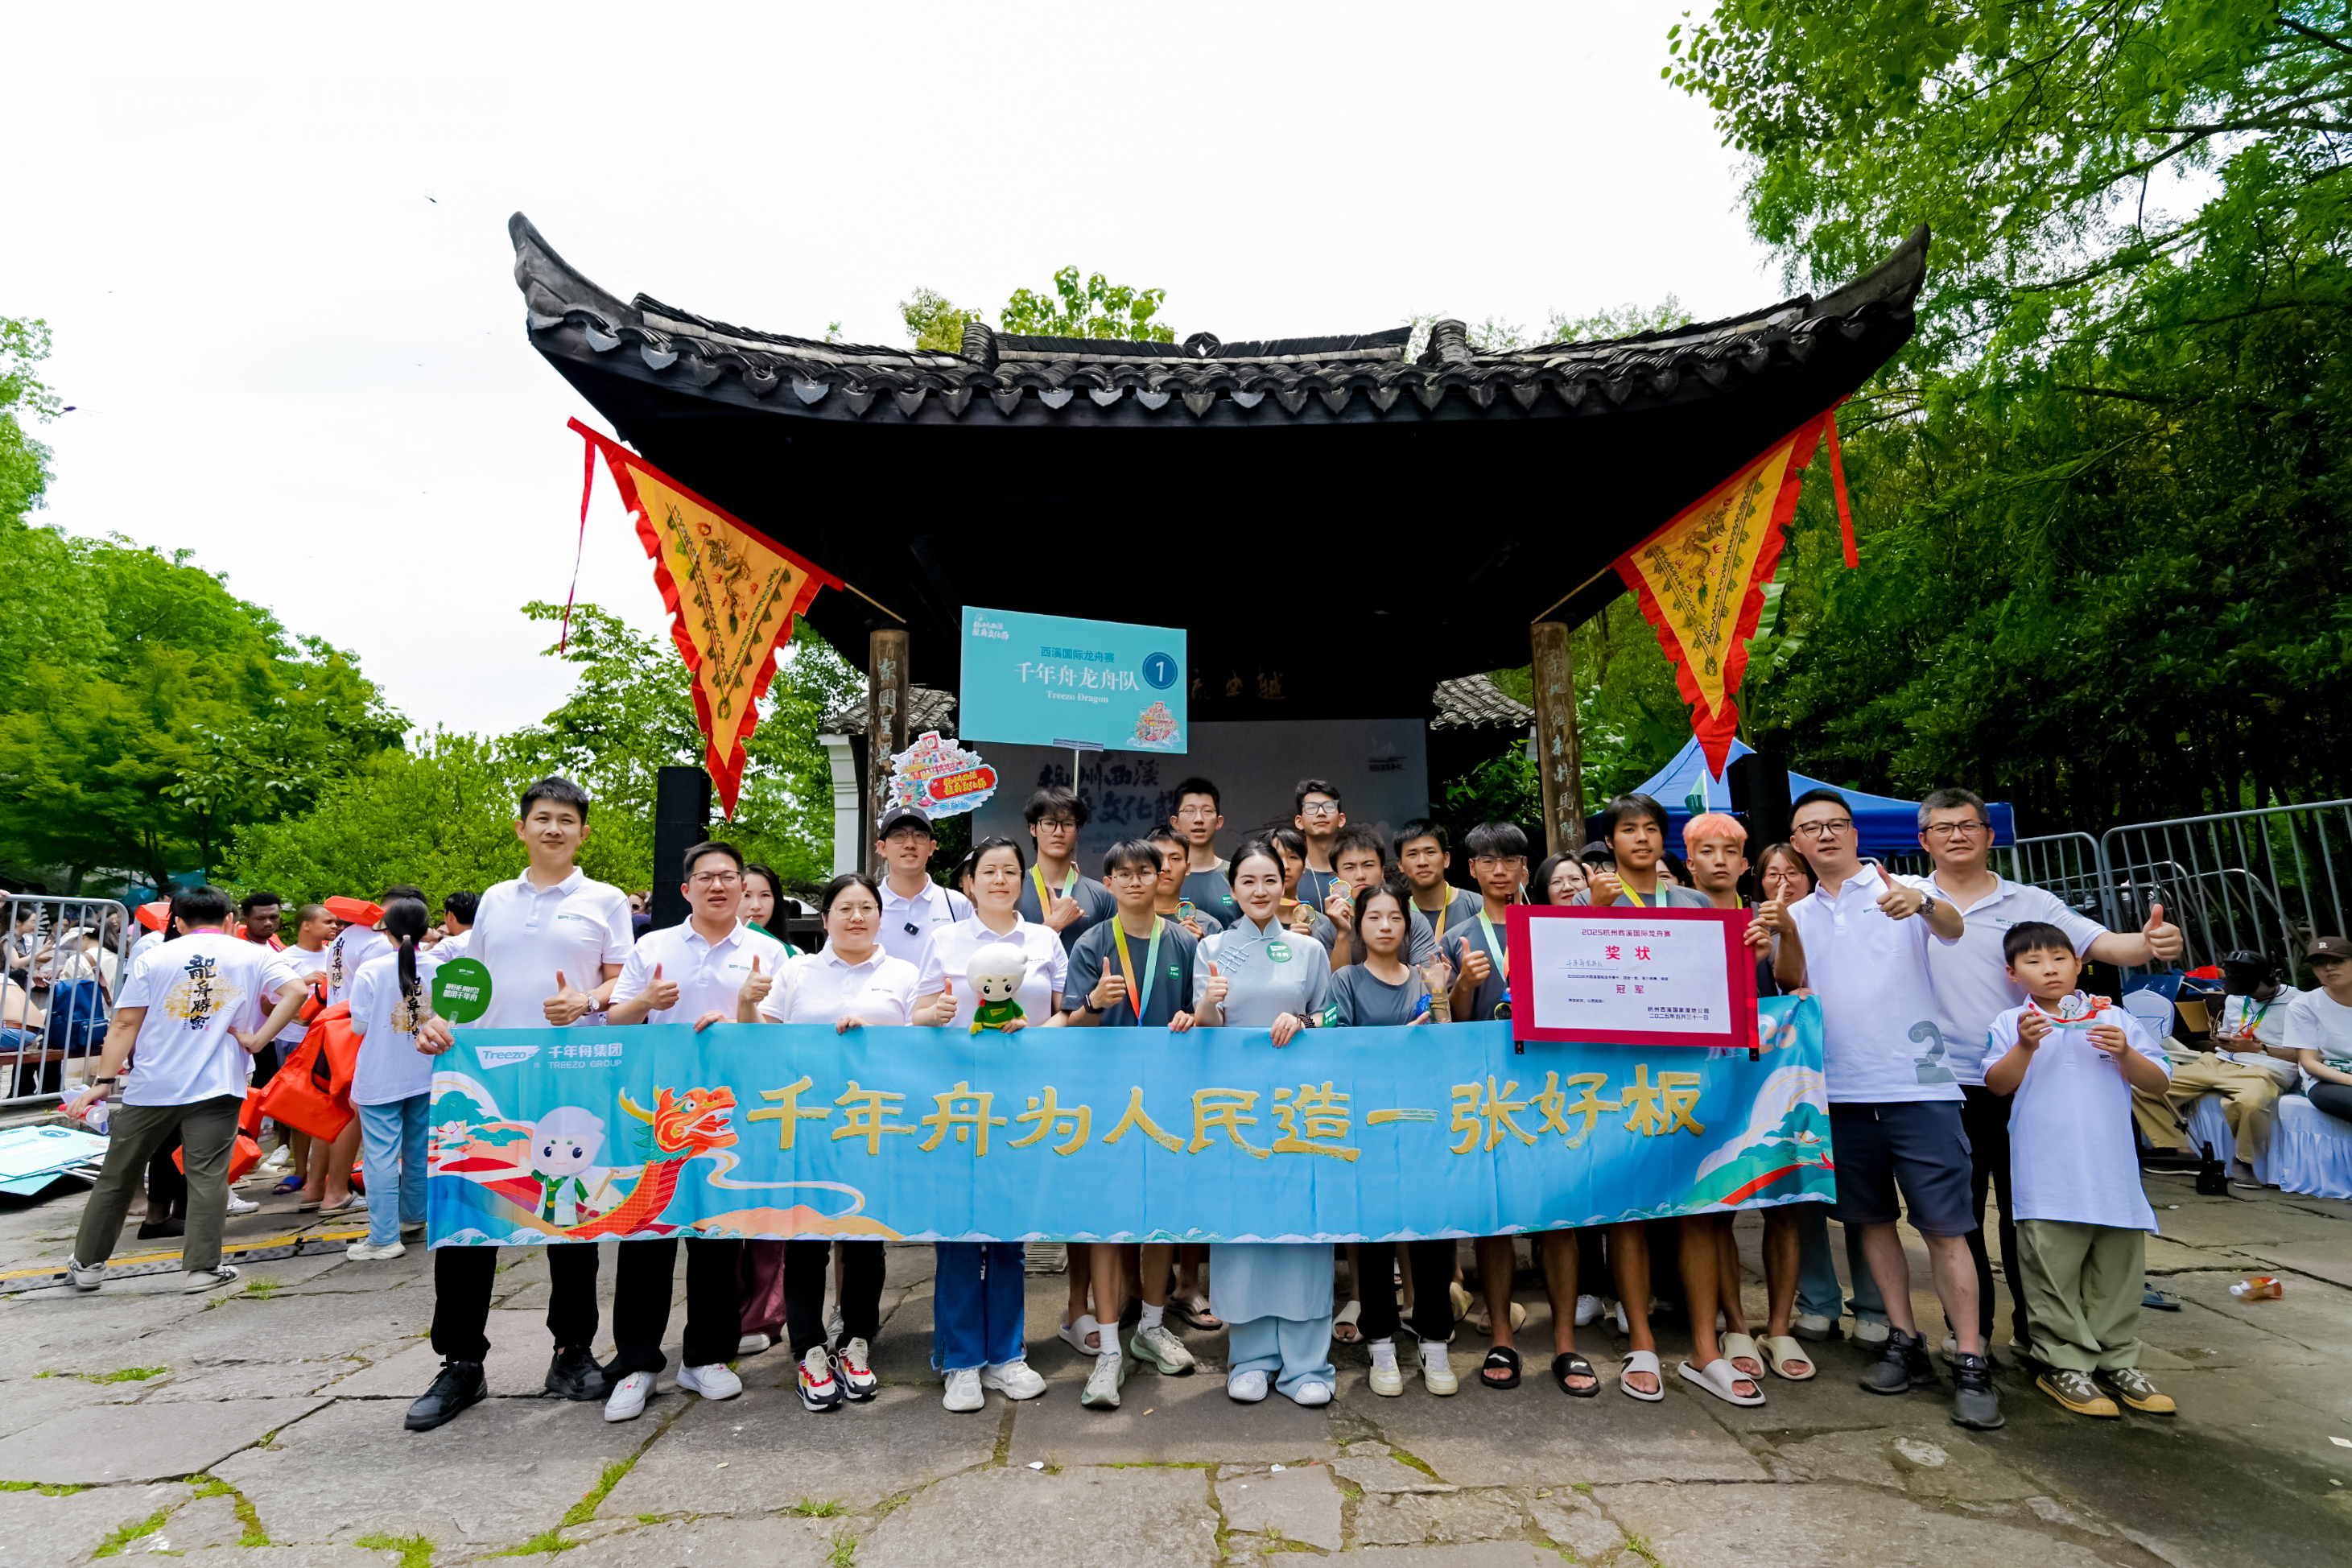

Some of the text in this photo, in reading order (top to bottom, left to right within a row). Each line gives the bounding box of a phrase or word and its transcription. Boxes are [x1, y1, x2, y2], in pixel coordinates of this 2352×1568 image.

[1040, 646, 1115, 664] 西溪国际龙舟赛
[1013, 662, 1140, 691] 千年舟龙舟队
[1156, 661, 1165, 682] 1
[1046, 690, 1109, 704] Treezo Dragon
[1581, 928, 1672, 938] 2025杭州西溪国际龙舟赛
[1615, 984, 1644, 995] 冠军
[482, 1050, 527, 1060] Treezo
[548, 1043, 623, 1058] 千年舟集团
[548, 1059, 622, 1069] TREEZO GROUP
[746, 1064, 1706, 1162] 千年舟为人民造一张好板
